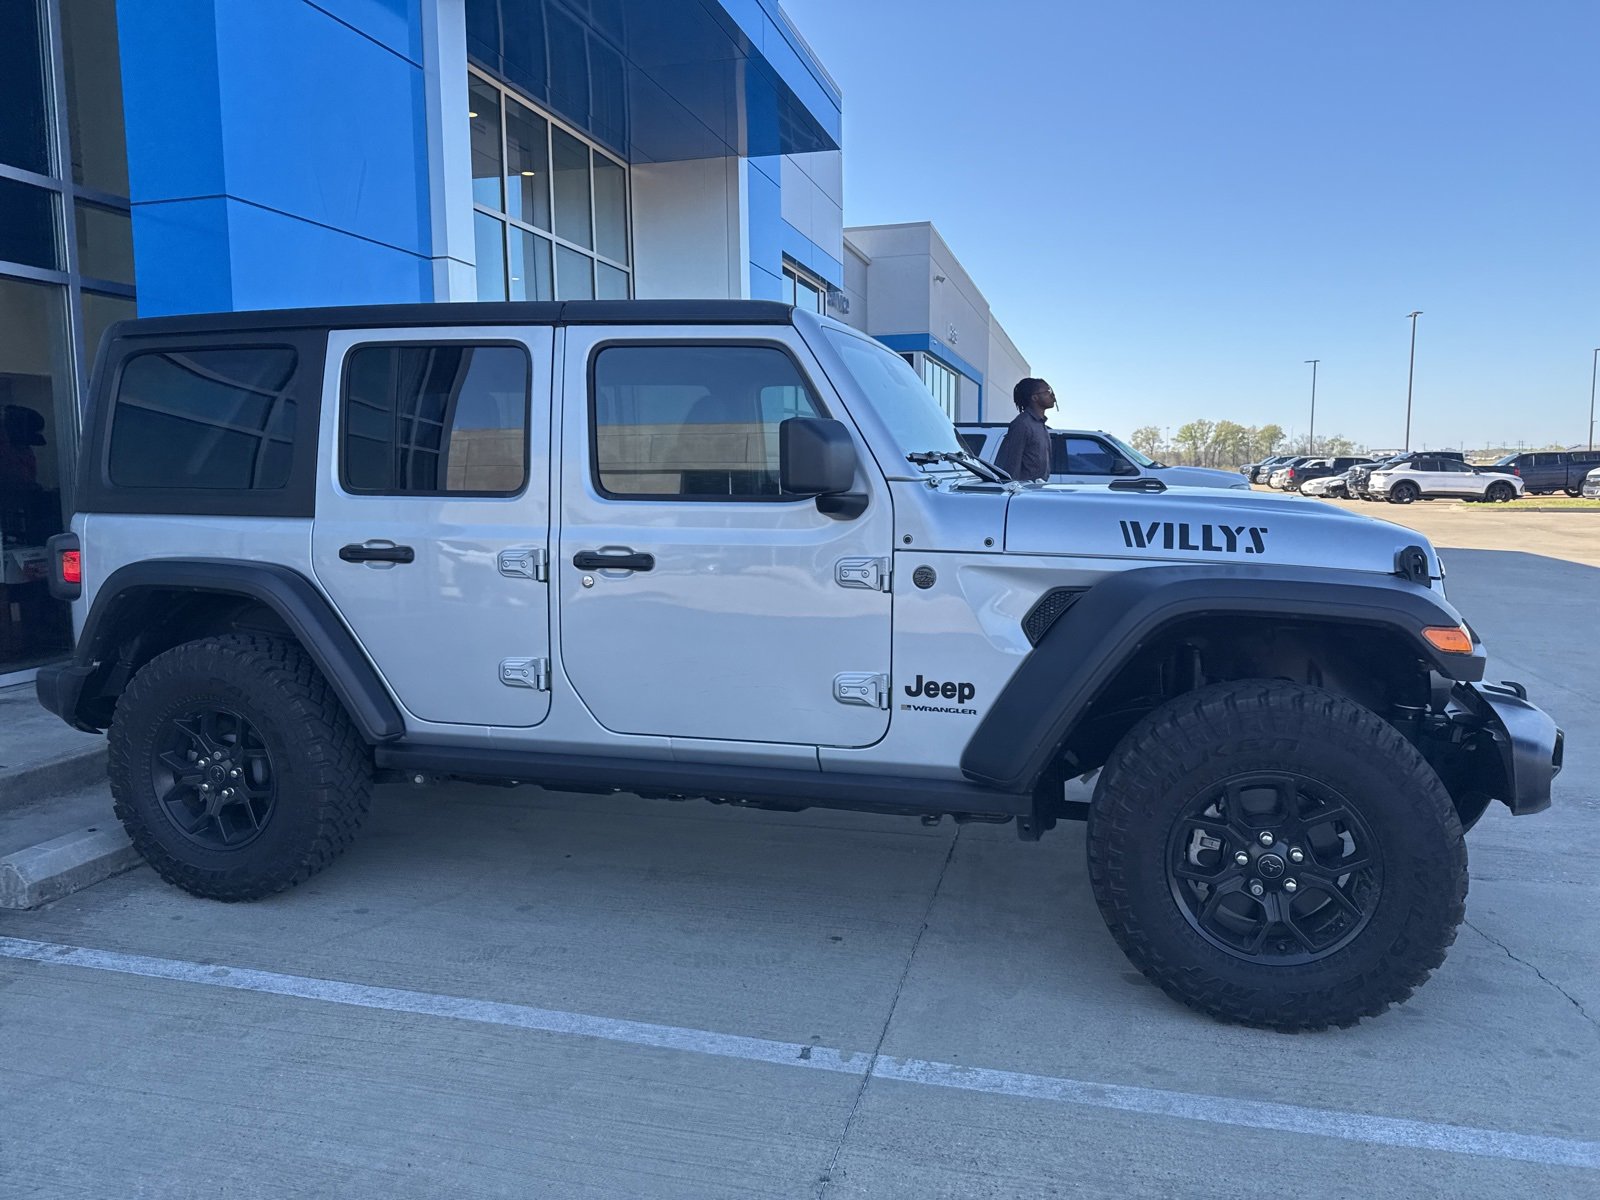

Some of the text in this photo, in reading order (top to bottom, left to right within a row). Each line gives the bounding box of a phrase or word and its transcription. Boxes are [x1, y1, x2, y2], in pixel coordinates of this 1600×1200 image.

[1119, 520, 1268, 554] WILLYS
[904, 674, 976, 704] Jeep
[912, 704, 977, 715] WRANGLER
